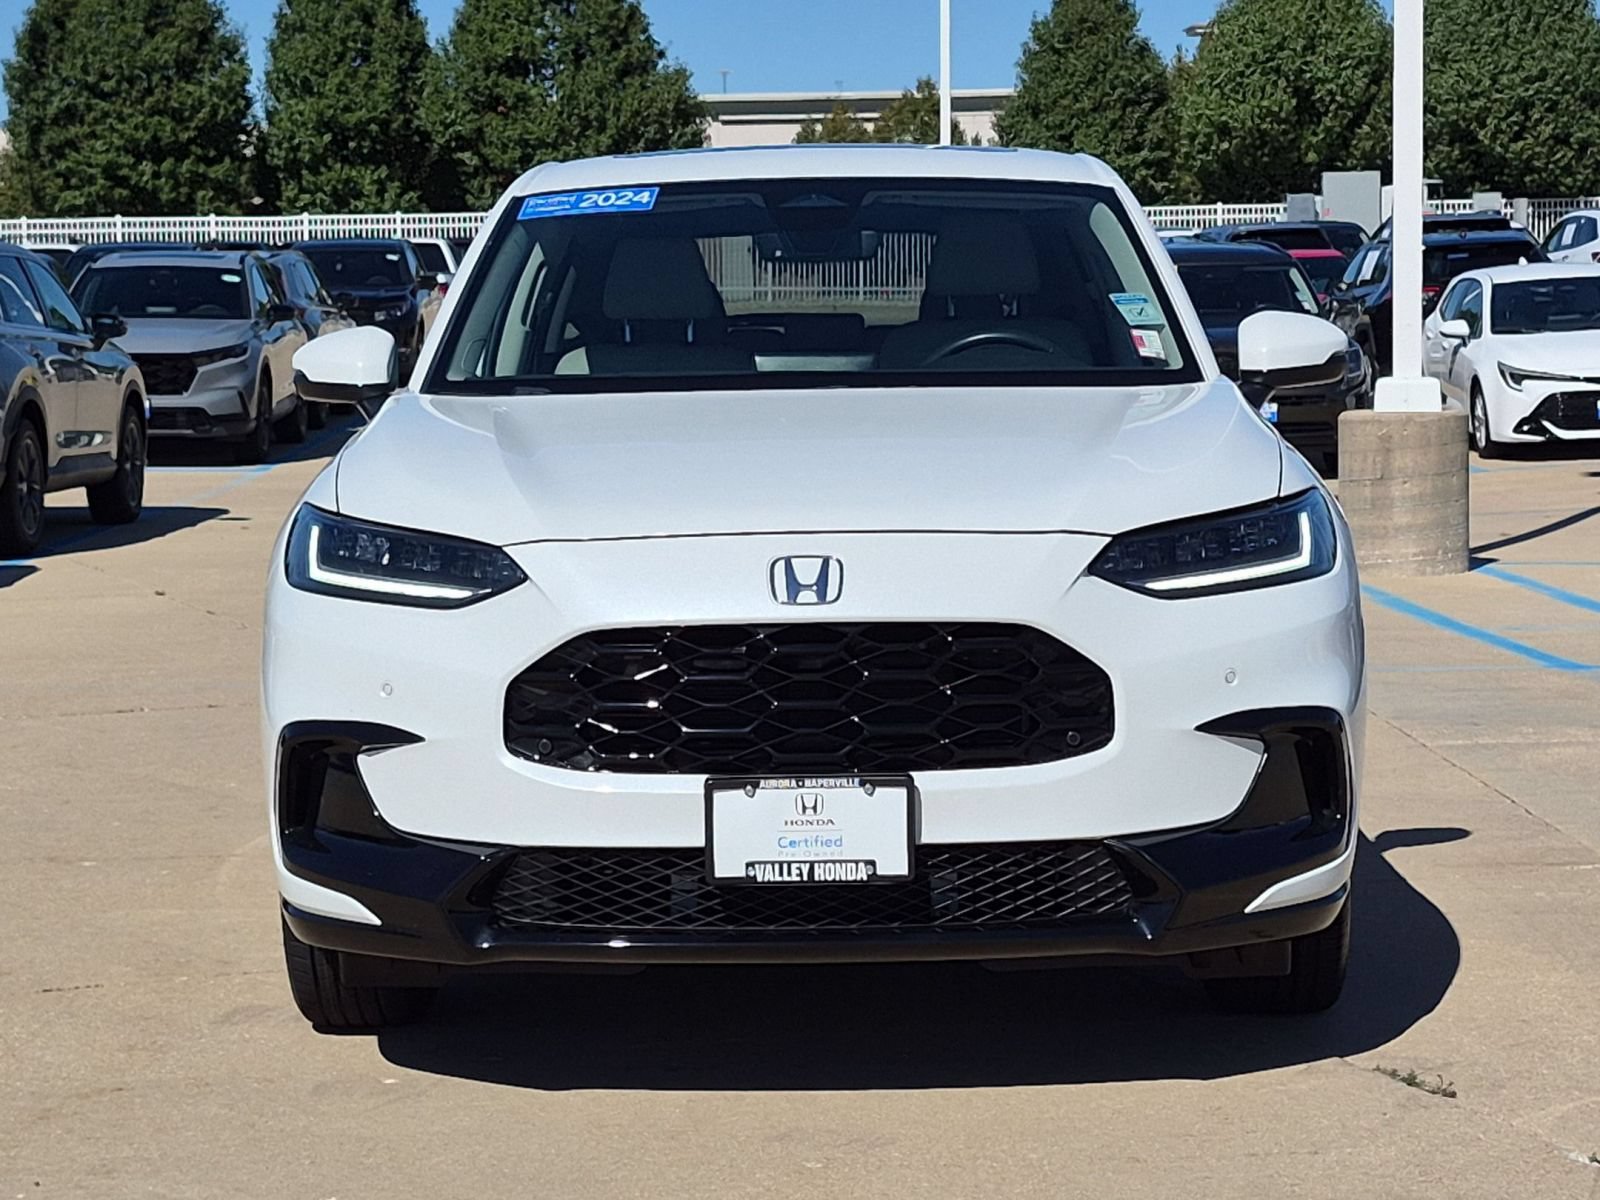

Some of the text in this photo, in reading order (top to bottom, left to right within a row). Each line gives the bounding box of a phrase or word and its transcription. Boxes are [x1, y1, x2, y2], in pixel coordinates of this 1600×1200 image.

[579, 191, 651, 208] 2024
[777, 835, 843, 848] Certified
[755, 862, 868, 882] VALLEY HONDA
